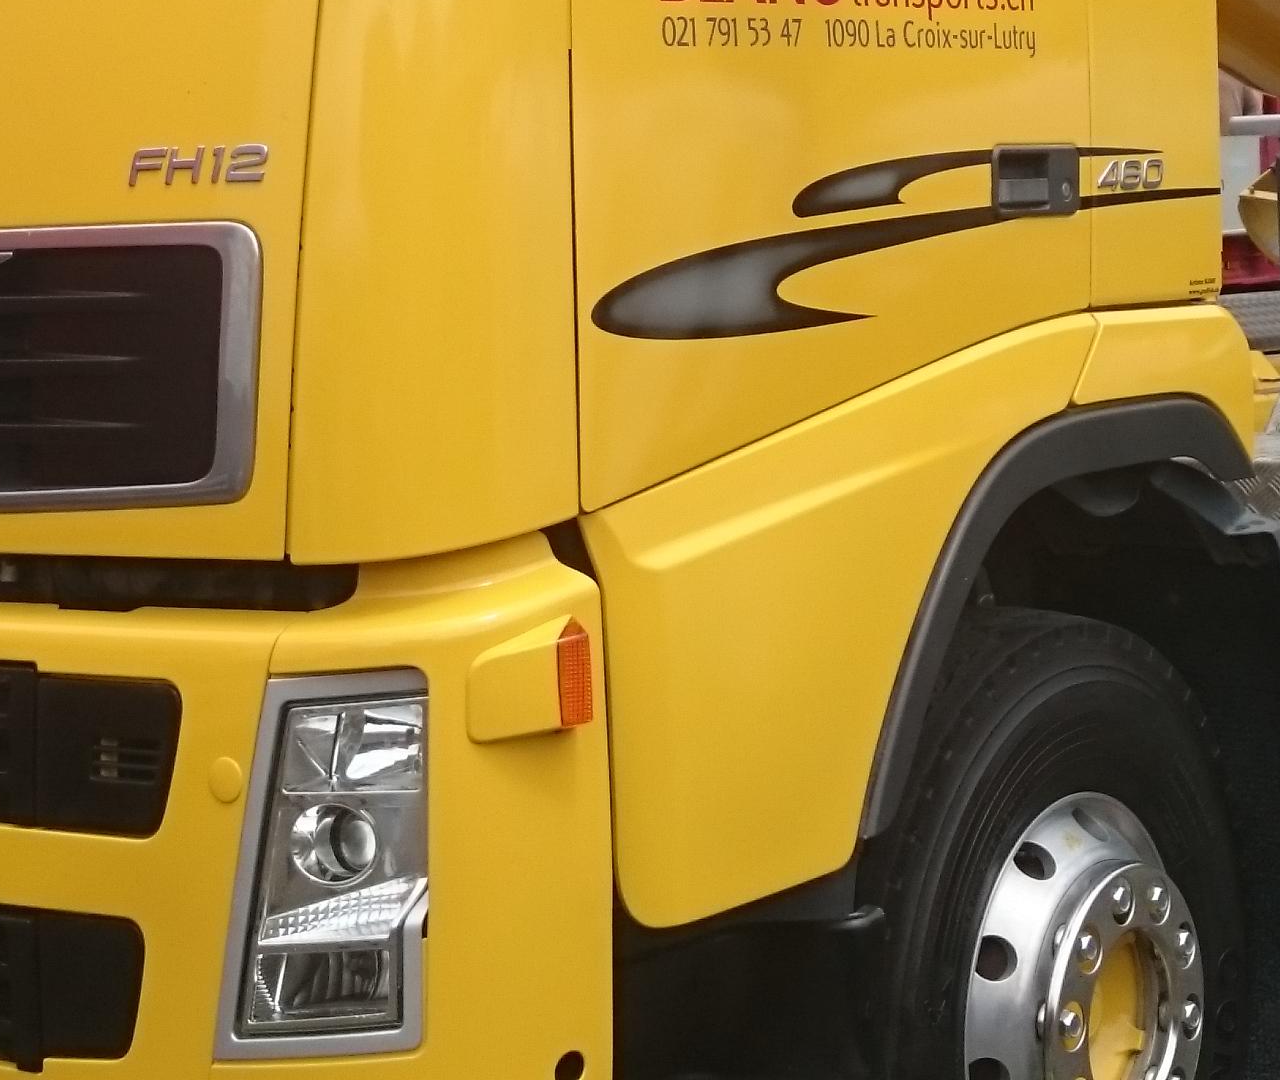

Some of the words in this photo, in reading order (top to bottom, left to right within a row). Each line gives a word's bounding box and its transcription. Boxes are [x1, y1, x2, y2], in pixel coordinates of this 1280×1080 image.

[662, 16, 696, 47] 021
[706, 17, 738, 47] 791
[747, 18, 771, 48] 53
[780, 18, 802, 48] 47
[825, 19, 869, 48] 1090
[876, 20, 896, 49] La
[903, 21, 1036, 58] Croix-sur-Lutry
[128, 142, 271, 188] FH12
[1097, 158, 1164, 191] 460
